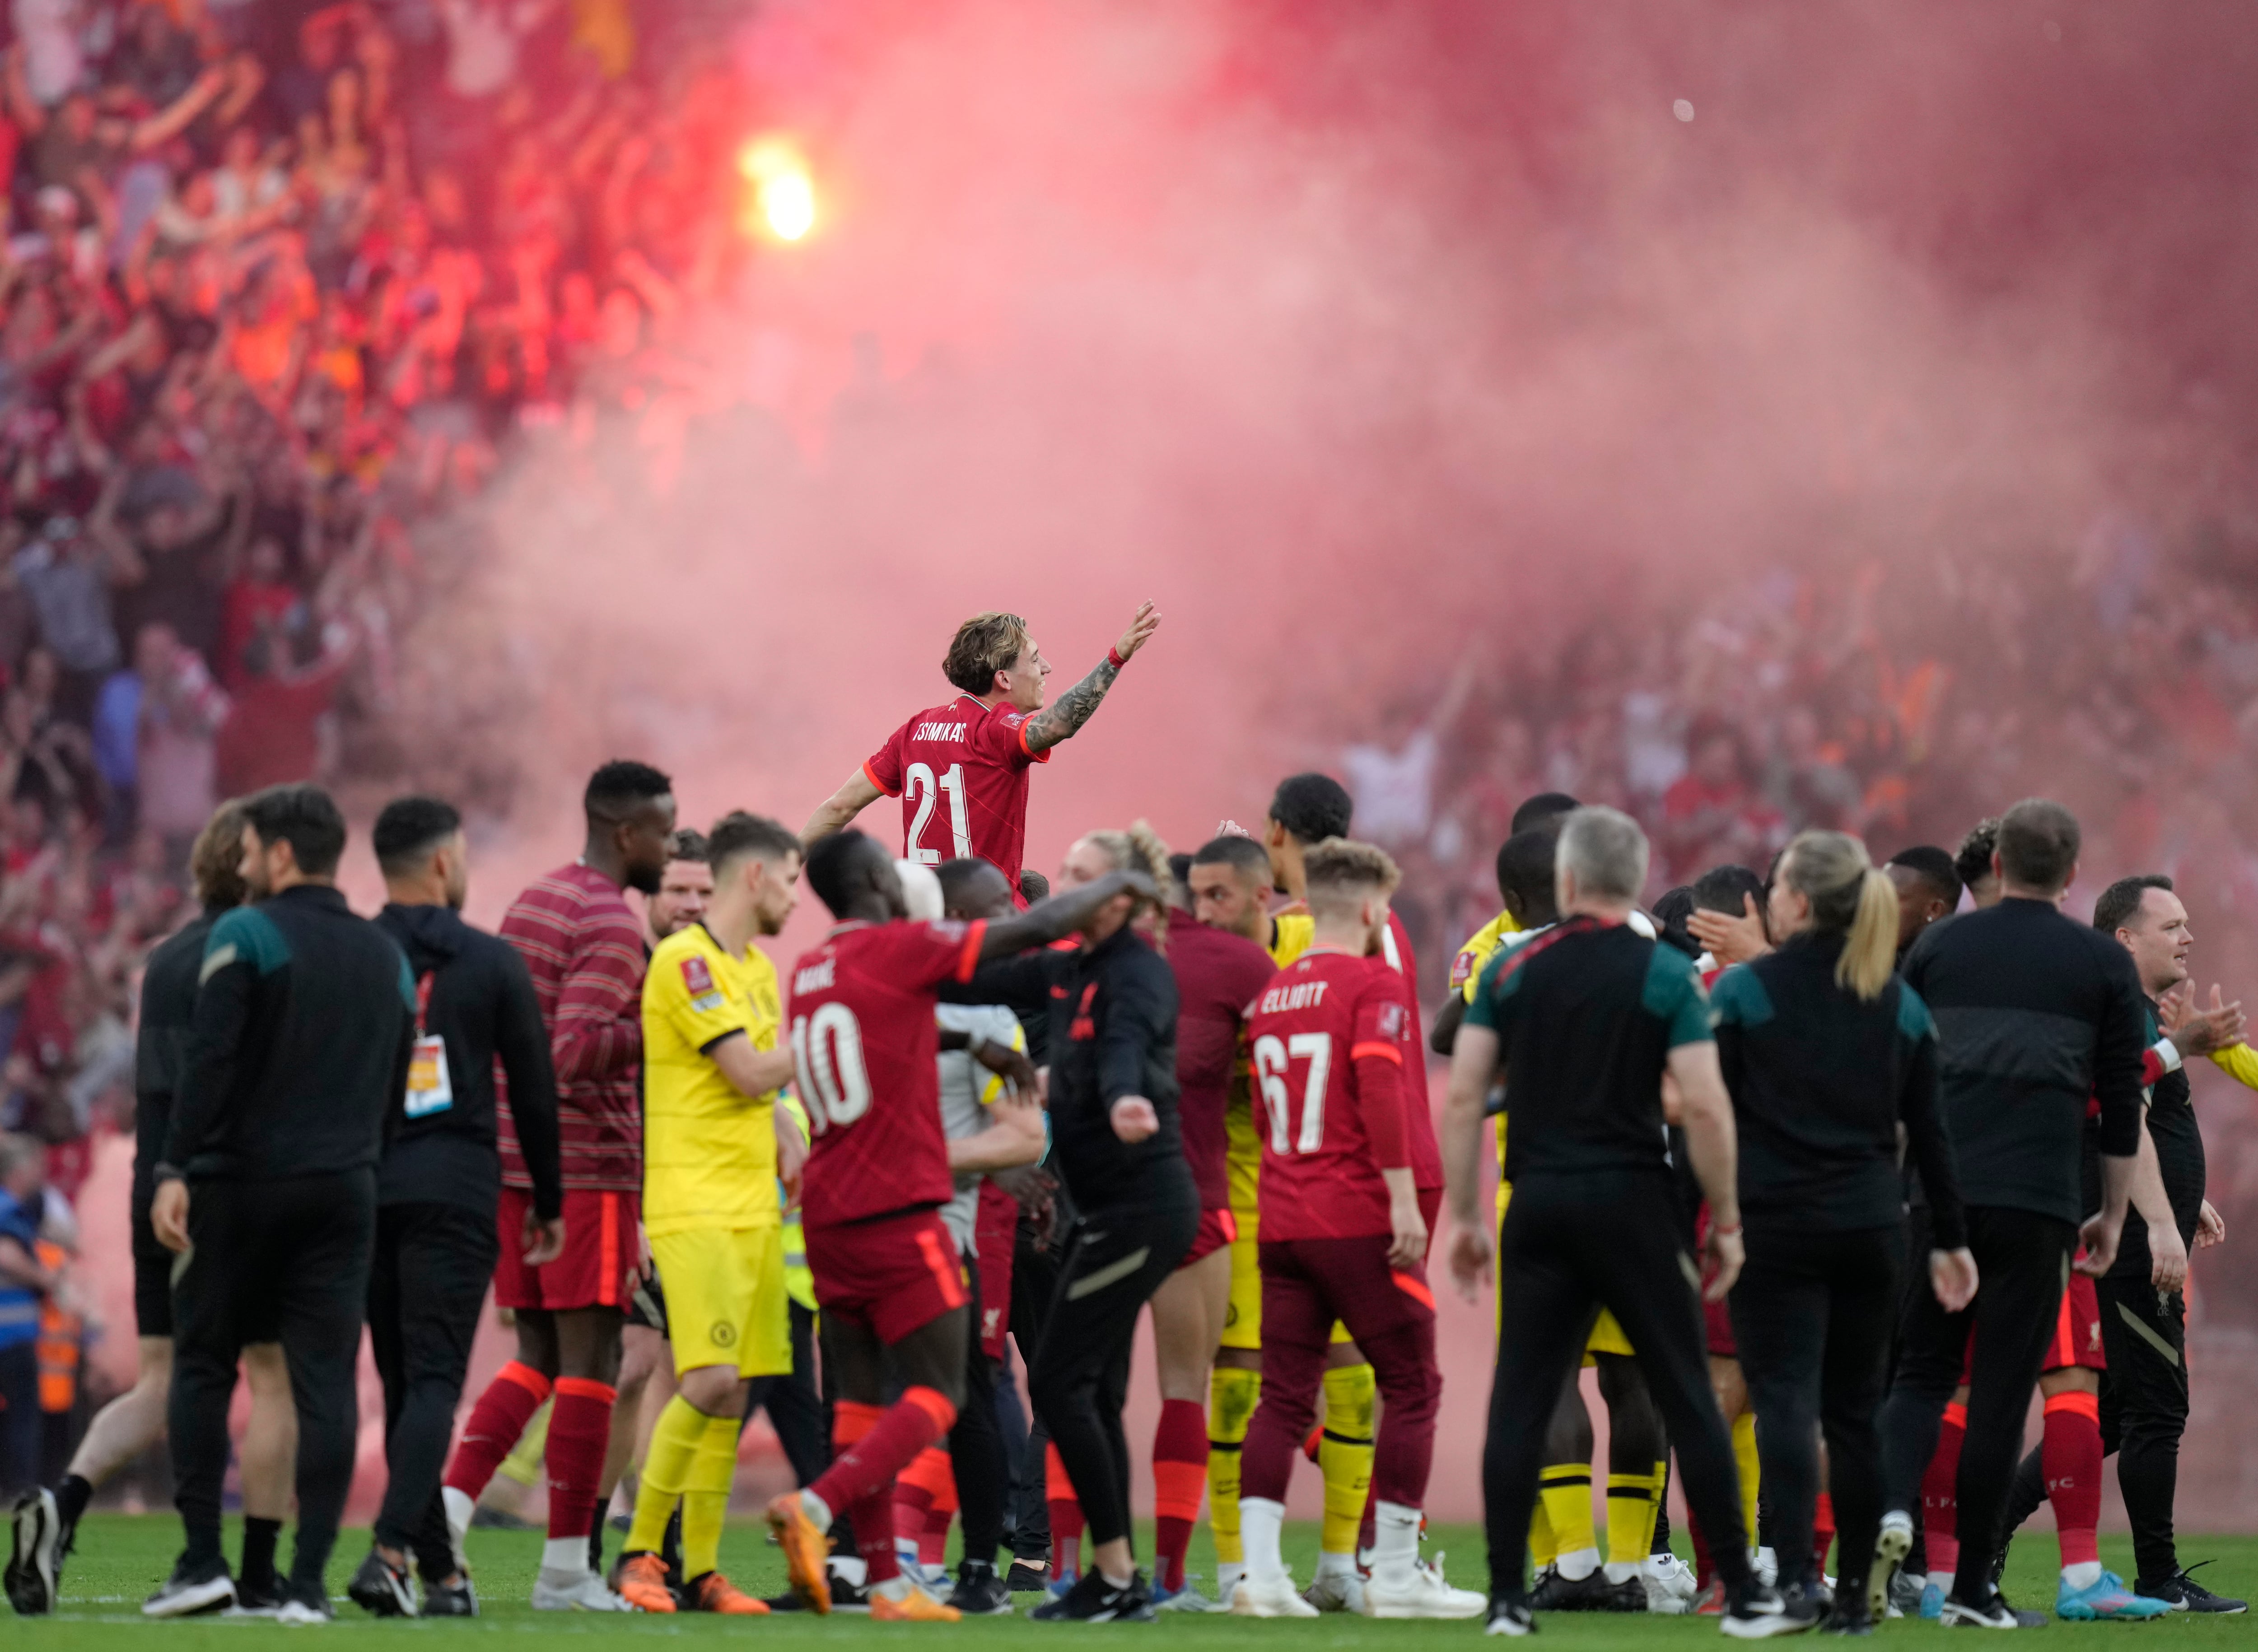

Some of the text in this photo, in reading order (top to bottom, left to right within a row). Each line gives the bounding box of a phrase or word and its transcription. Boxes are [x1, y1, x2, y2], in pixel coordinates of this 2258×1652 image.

[912, 722, 966, 743] TSIMIKAS
[905, 762, 973, 867] 21
[1261, 981, 1328, 1014] ELLIOTT
[791, 1002, 874, 1137] 10
[1254, 1032, 1332, 1155] 67
